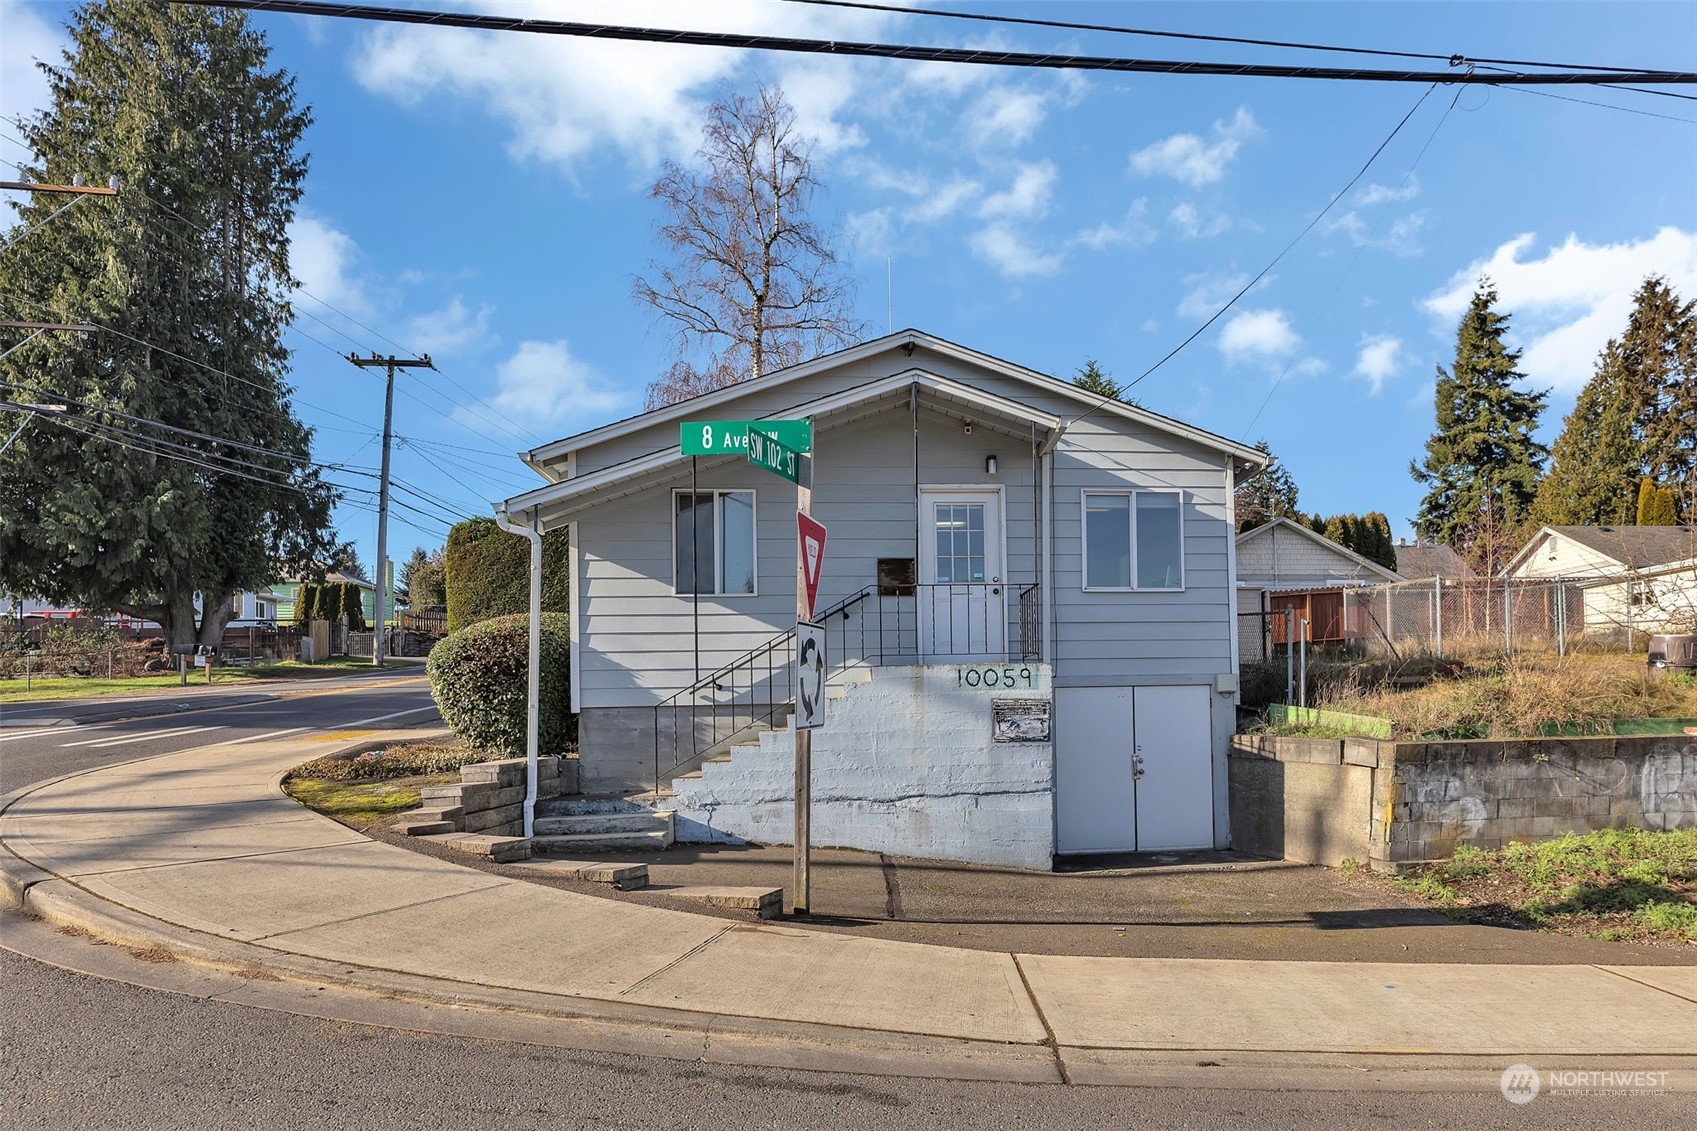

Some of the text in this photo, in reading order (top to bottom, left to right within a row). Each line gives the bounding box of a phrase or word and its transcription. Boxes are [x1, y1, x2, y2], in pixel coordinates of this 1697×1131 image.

[702, 425, 713, 449] 8
[723, 432, 748, 448] Ave
[750, 432, 795, 477] SW 102 ST
[958, 668, 1031, 688] 10059
